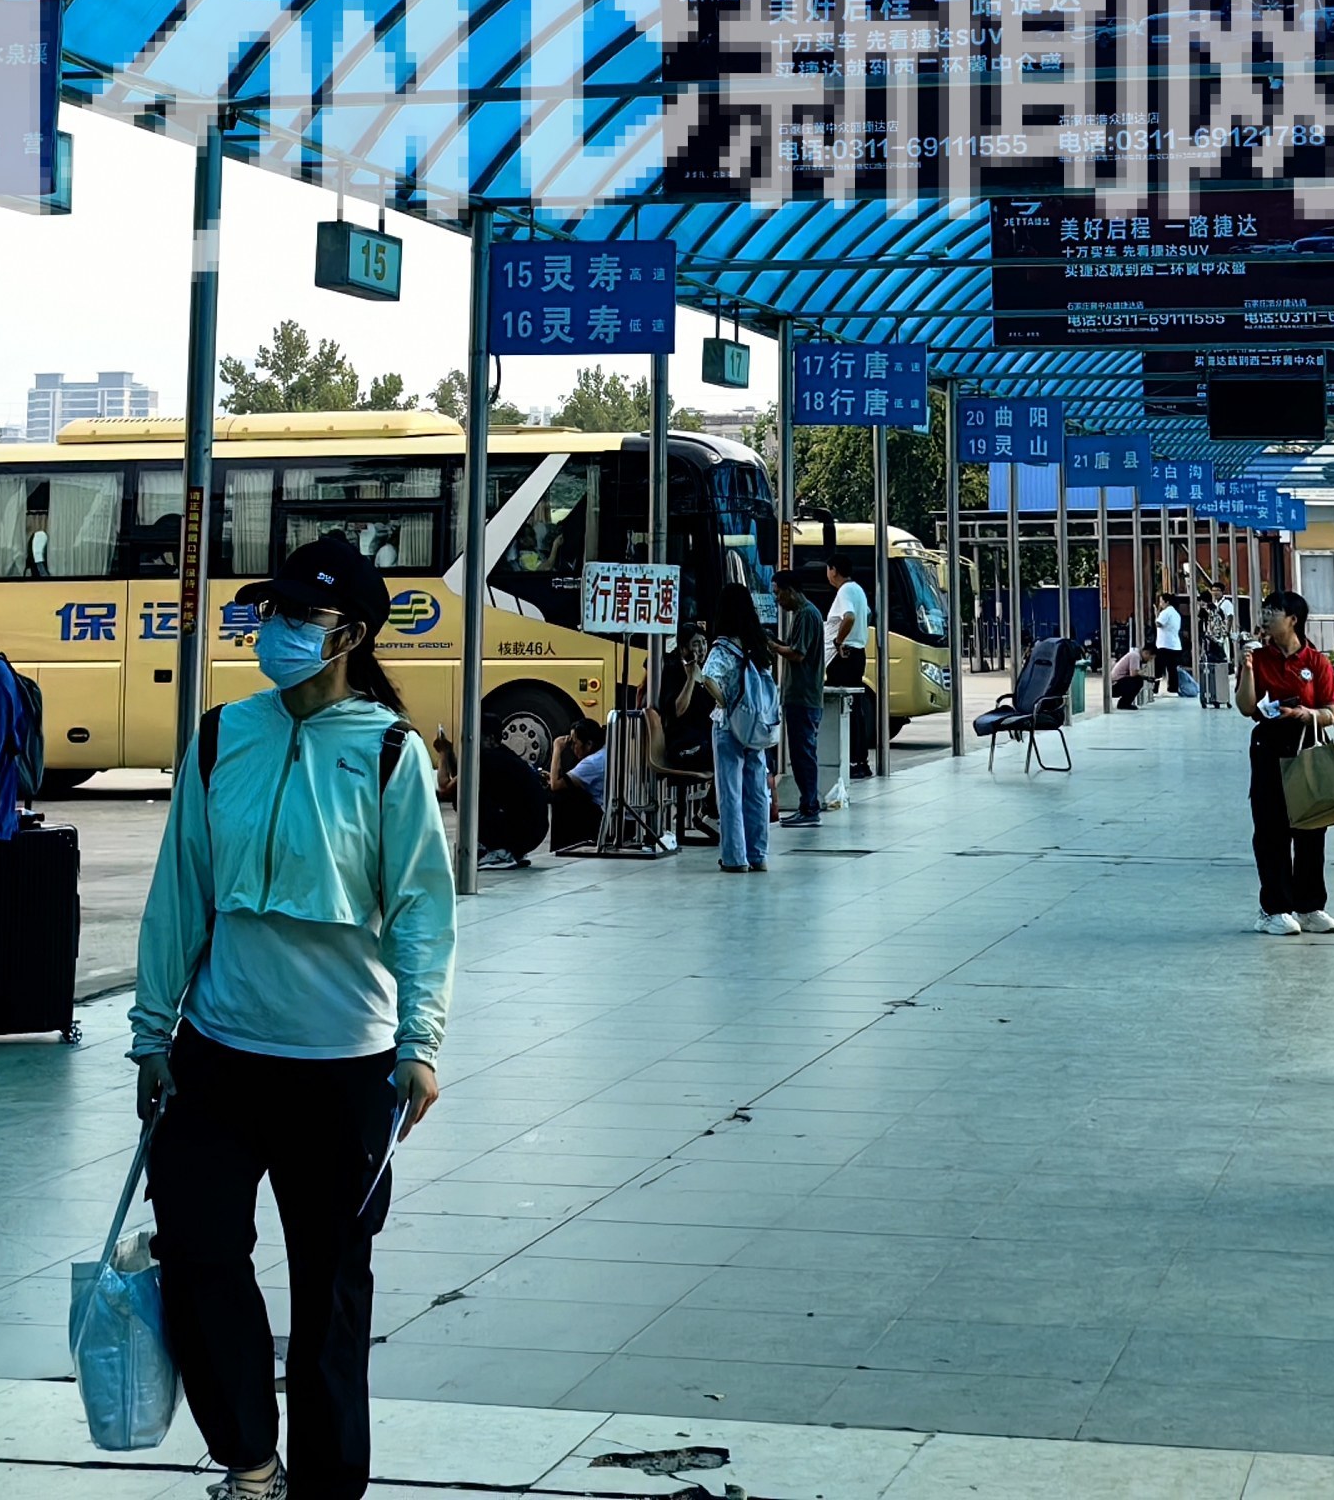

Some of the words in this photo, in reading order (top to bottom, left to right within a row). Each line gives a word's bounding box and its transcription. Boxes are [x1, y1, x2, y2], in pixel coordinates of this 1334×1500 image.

[361, 239, 387, 281] 15
[503, 261, 532, 288] 15
[540, 253, 622, 292] 灵寿
[503, 311, 532, 338] 16
[540, 305, 622, 344] 灵寿
[730, 350, 743, 378] 17
[802, 356, 824, 375] 17
[830, 351, 889, 380] 行唐
[802, 391, 824, 411] 18
[829, 388, 889, 416] 行唐
[966, 410, 985, 426] 20
[995, 405, 1048, 428] 曲阳
[968, 438, 987, 455] 19
[994, 434, 1048, 457] 灵山
[1074, 454, 1088, 468] 21
[591, 572, 674, 624] 行唐高速
